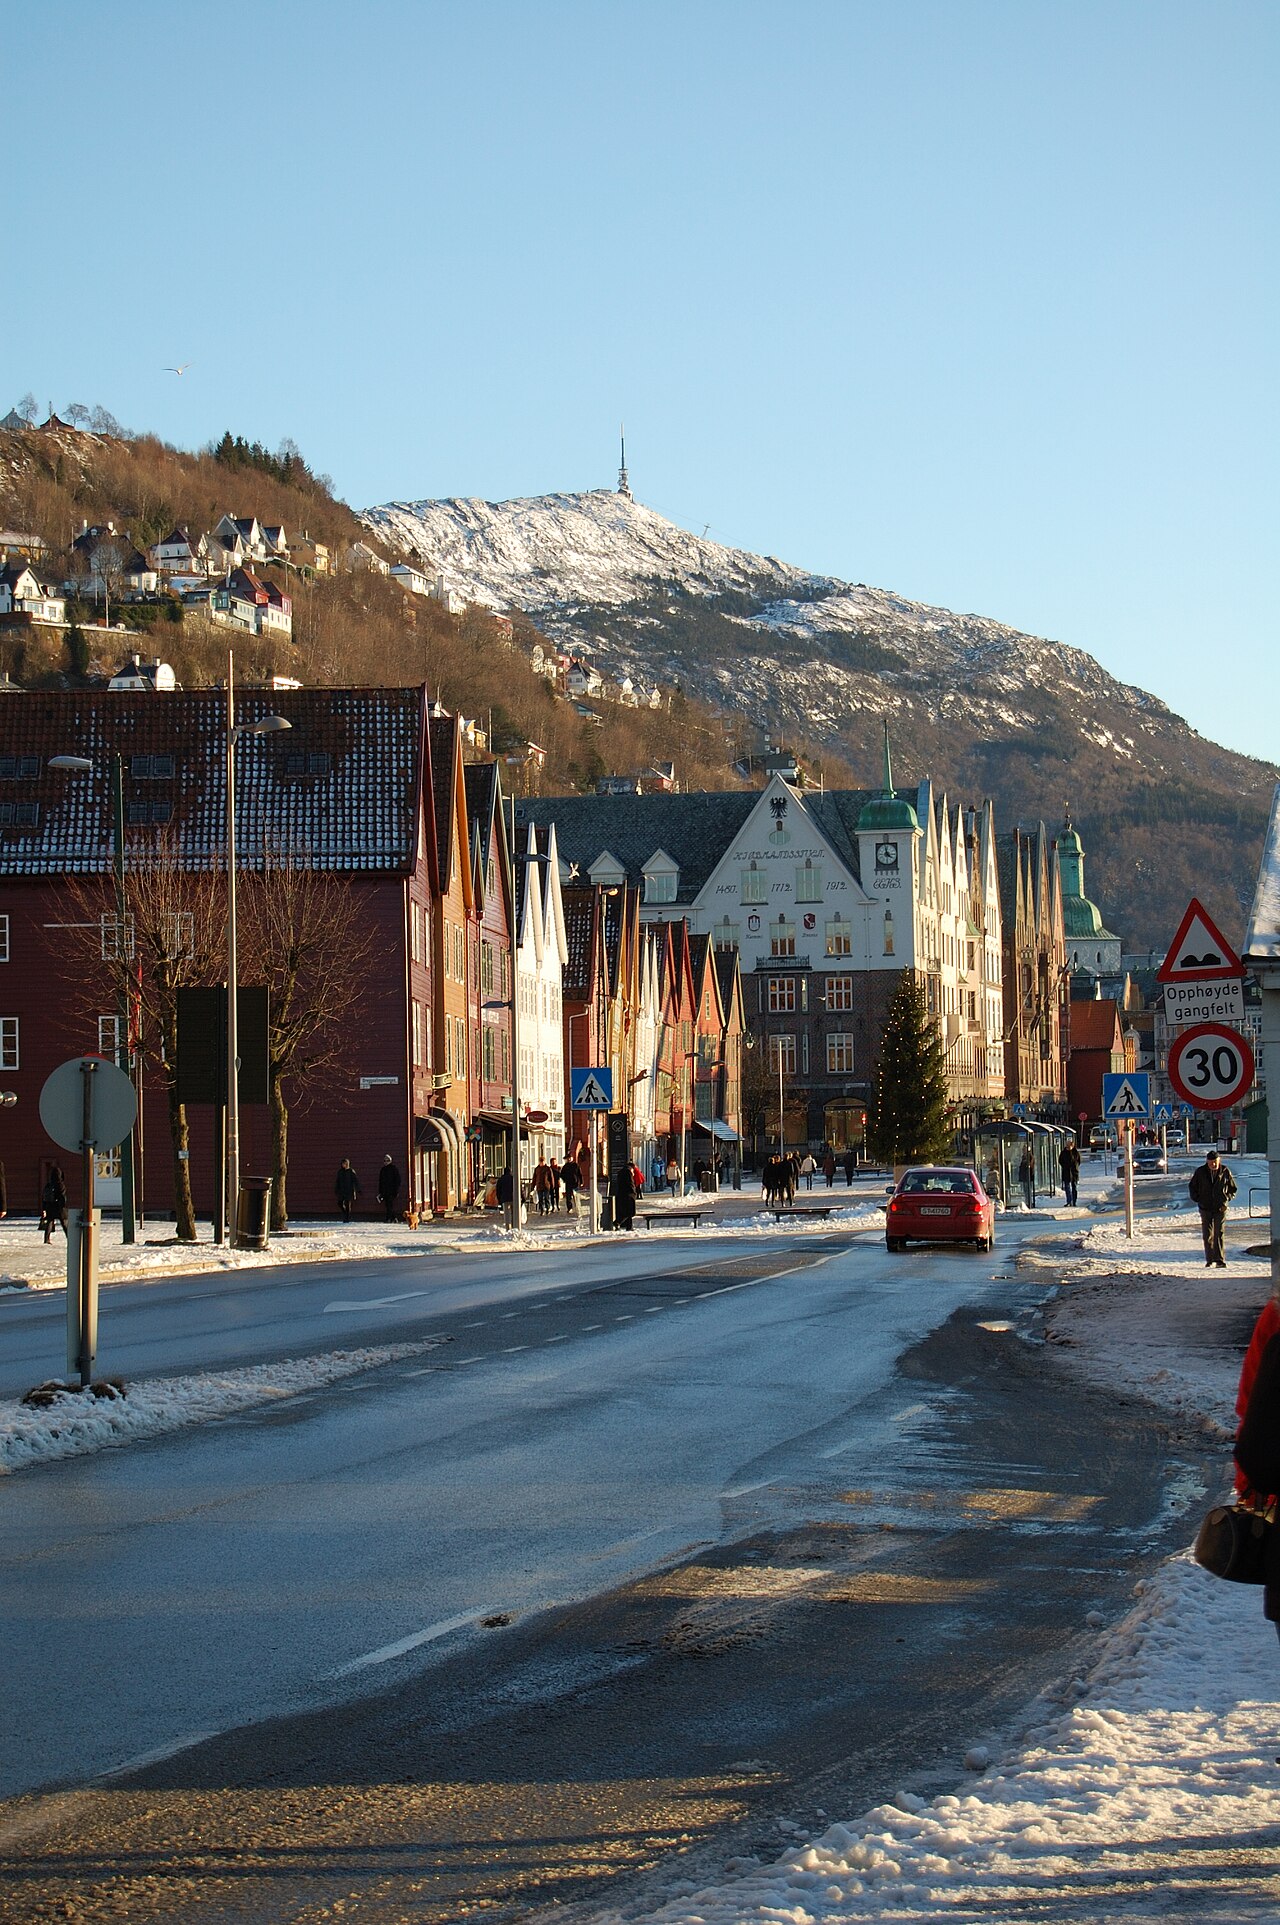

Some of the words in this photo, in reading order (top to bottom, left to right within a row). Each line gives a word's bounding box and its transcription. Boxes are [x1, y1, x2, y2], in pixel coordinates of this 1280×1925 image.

[770, 883, 793, 893] 1712.
[826, 881, 848, 890] 1912.
[1167, 983, 1239, 1002] Opphøyde
[1174, 1002, 1235, 1020] gangfelt
[1185, 1046, 1238, 1087] 30
